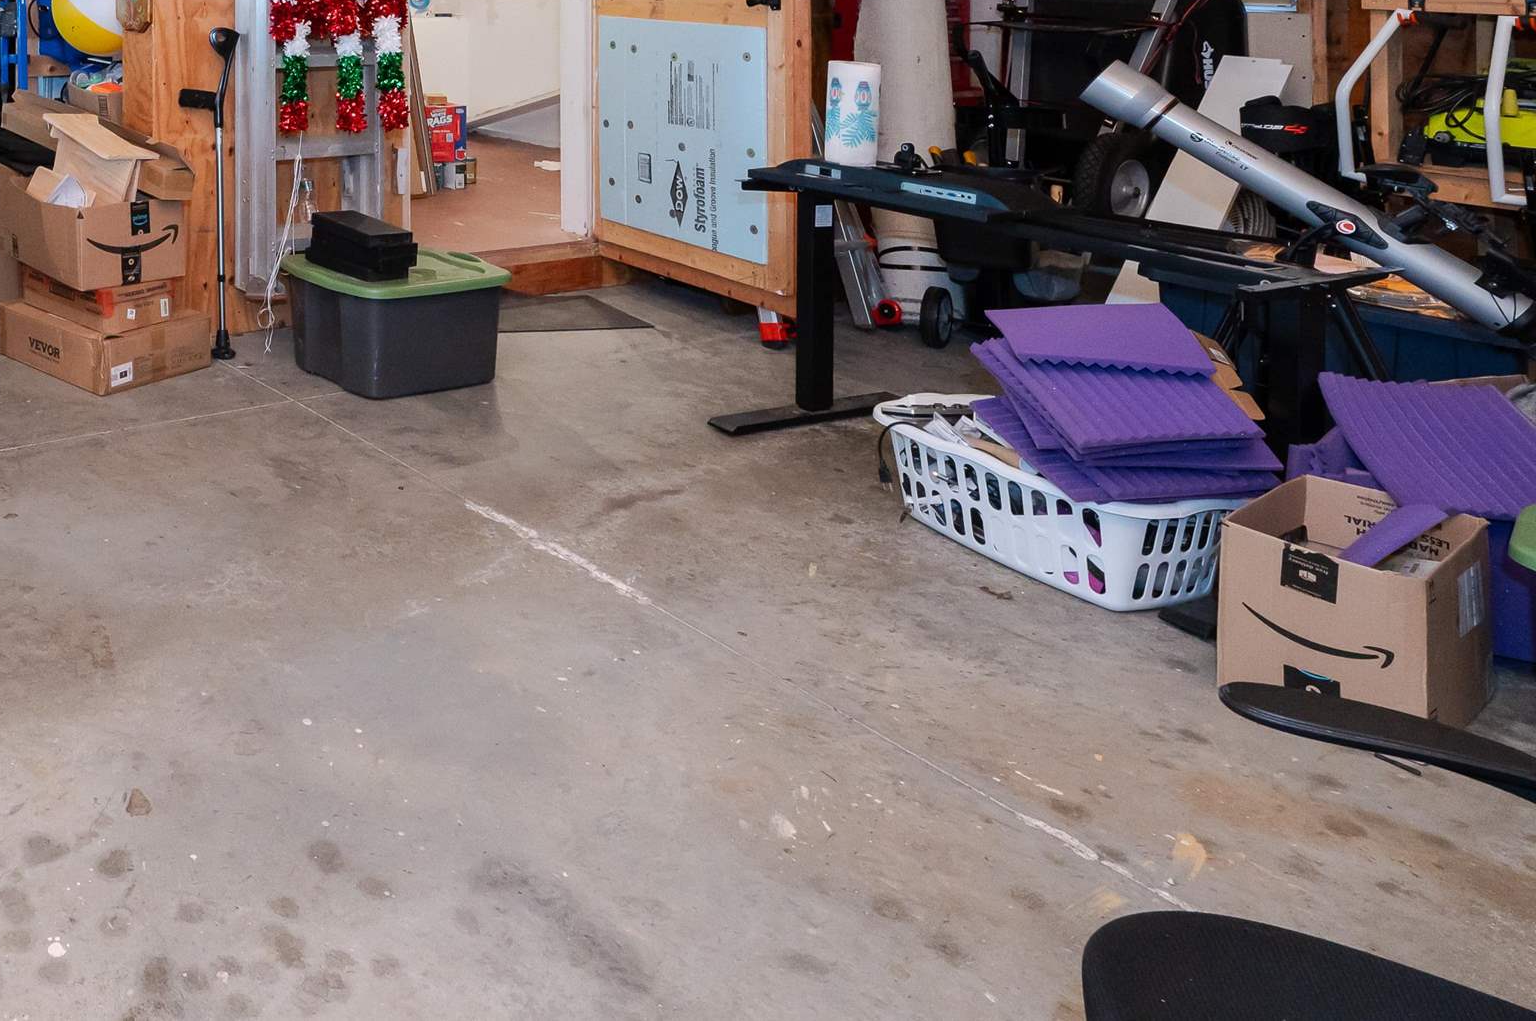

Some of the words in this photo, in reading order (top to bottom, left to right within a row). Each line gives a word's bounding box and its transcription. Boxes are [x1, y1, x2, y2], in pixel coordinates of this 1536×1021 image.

[427, 114, 453, 128] RAGS
[675, 176, 684, 213] DOW
[694, 167, 708, 233] Styrofoam
[28, 337, 61, 359] VEVOR
[1344, 514, 1377, 528] RIAL
[1421, 534, 1450, 551] LESS
